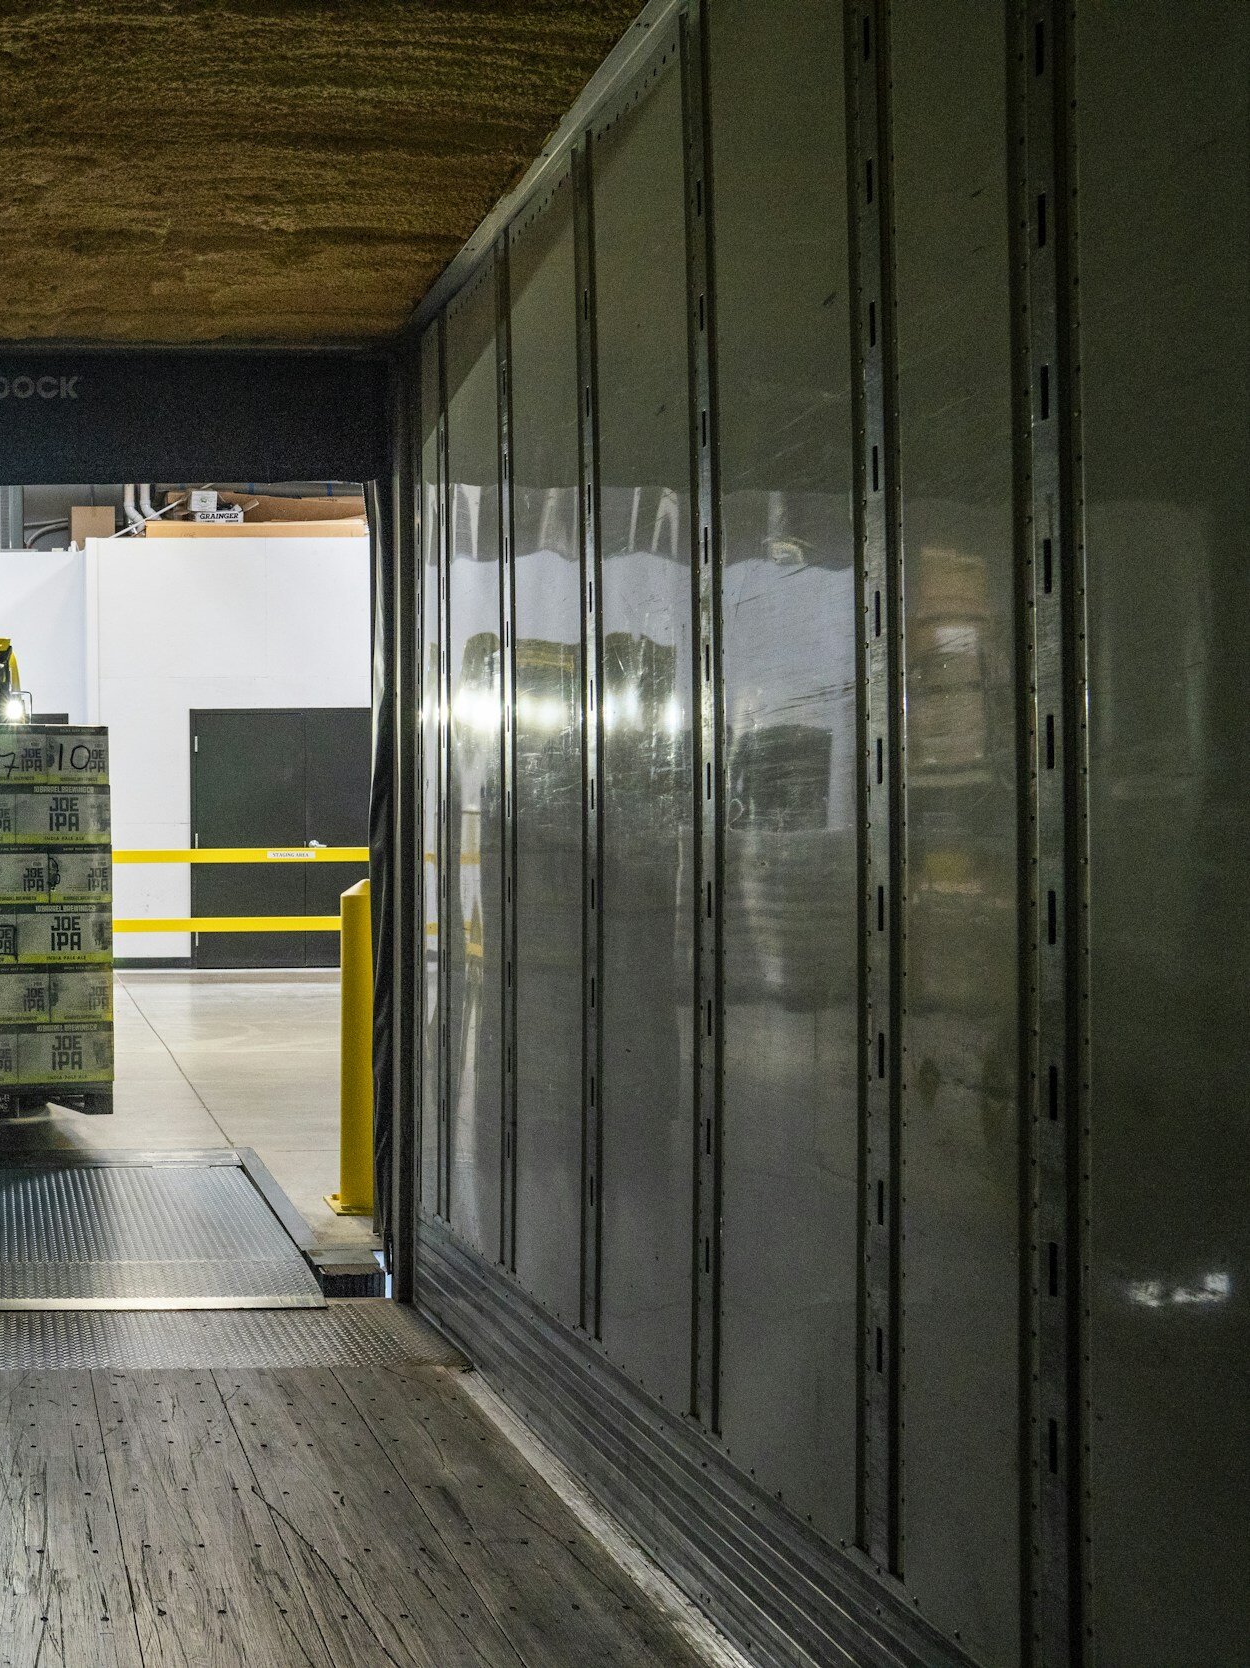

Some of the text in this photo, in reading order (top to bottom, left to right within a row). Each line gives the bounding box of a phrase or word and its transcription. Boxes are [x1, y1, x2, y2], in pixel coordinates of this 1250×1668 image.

[200, 512, 239, 520] GRAINGER
[21, 748, 42, 758] JOE
[58, 743, 91, 770] 10
[21, 759, 42, 772] IPA
[50, 797, 79, 812] JOE
[50, 812, 79, 831] IPA
[23, 868, 44, 878] JOE
[88, 868, 108, 878] JOE
[23, 879, 44, 892] IPA
[88, 879, 108, 892] IPA
[51, 916, 80, 931] JOE
[51, 932, 81, 951] IPA
[23, 988, 44, 998] JOE
[24, 998, 45, 1011] IPA
[52, 1035, 82, 1050] JOE
[52, 1051, 82, 1070] IPA
